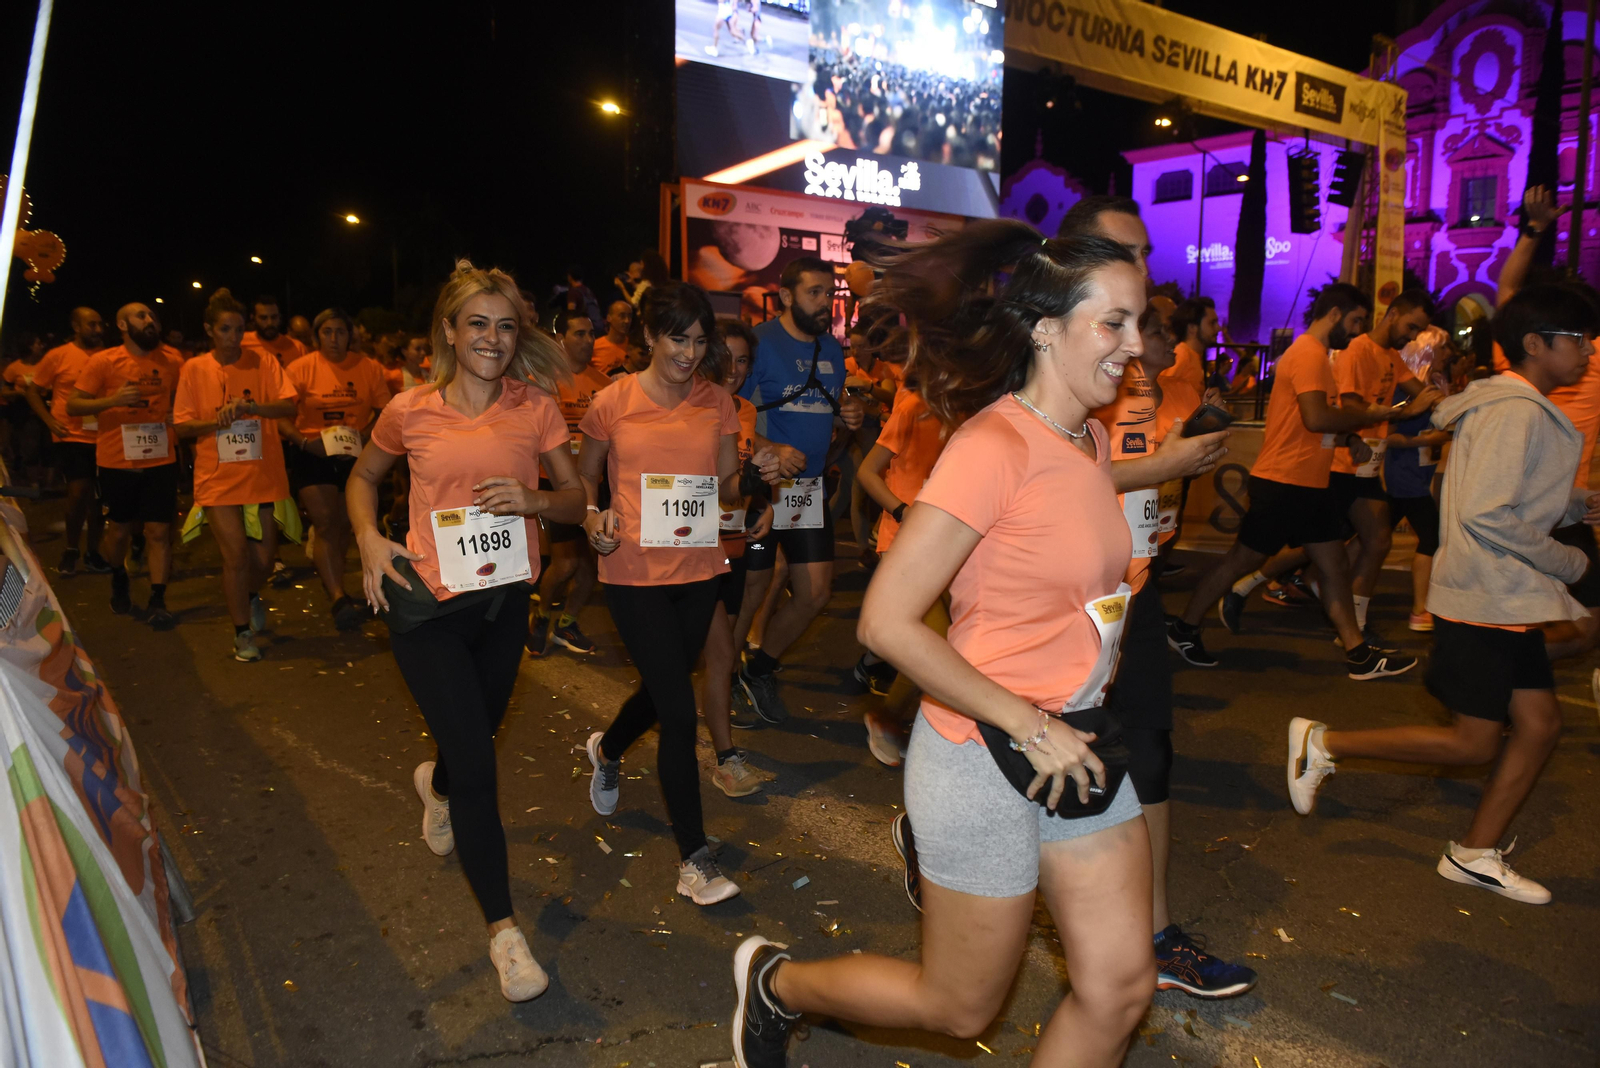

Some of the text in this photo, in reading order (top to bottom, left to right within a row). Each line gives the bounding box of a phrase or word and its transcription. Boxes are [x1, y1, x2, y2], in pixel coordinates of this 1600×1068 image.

[1004, 0, 1145, 58] NOCTURNA
[1152, 34, 1238, 86] SEVILLA
[136, 434, 158, 445] 7159
[226, 433, 256, 446] 14350
[333, 435, 358, 446] 14352
[662, 499, 705, 517] 11901
[457, 529, 512, 556] 11898
